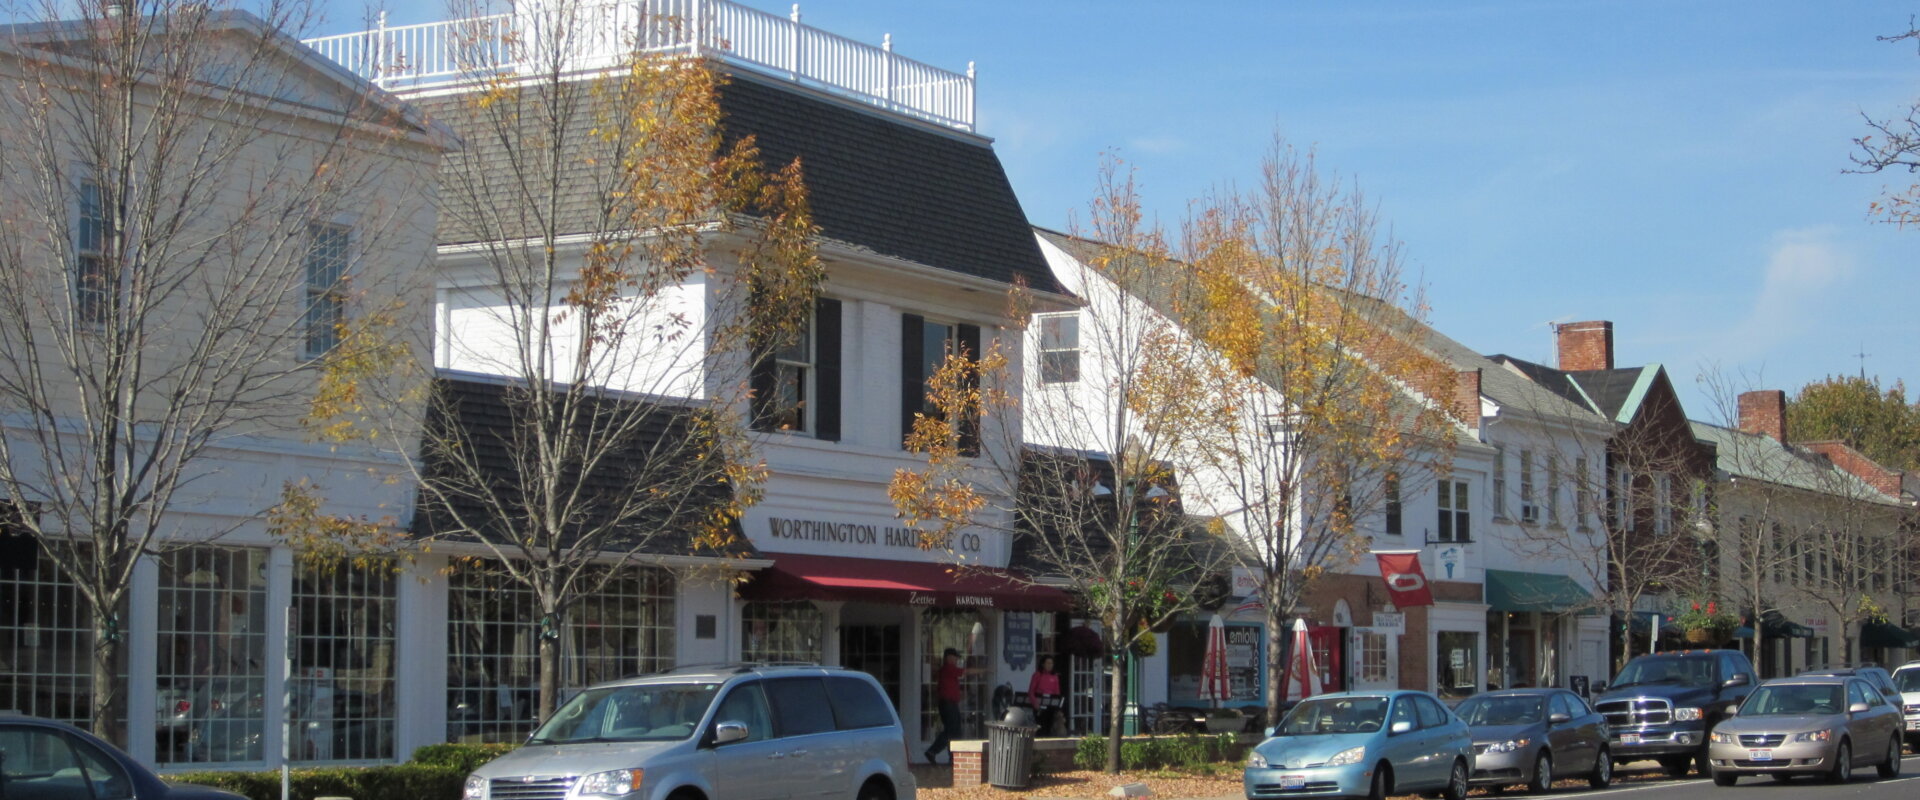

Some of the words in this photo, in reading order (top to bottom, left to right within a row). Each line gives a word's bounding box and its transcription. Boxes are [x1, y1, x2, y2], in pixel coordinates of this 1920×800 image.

[769, 517, 877, 544] WORTHINGTON
[961, 533, 981, 552] CO.
[955, 596, 994, 607] HARDWARE
[1229, 626, 1259, 648] emlolly
